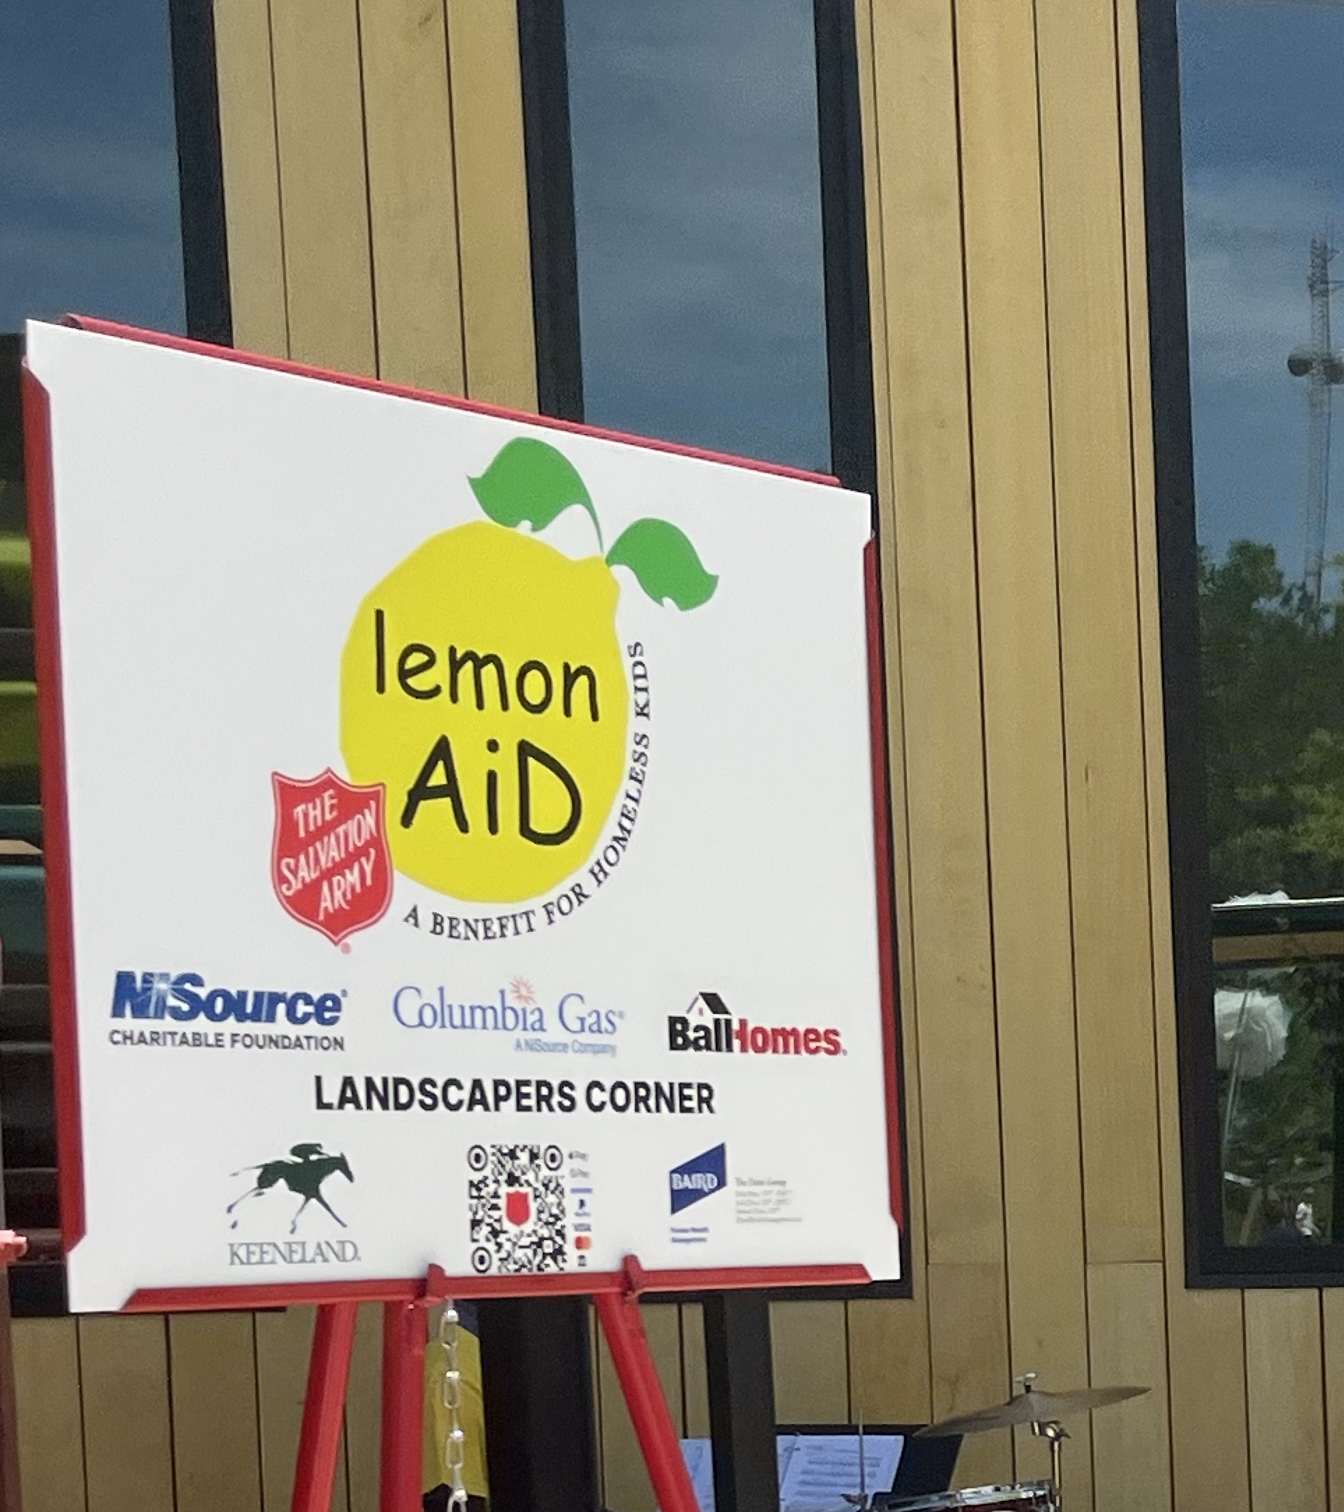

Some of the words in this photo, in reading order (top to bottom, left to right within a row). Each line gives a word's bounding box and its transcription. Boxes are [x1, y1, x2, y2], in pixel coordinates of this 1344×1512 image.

[375, 609, 600, 722] lemon
[293, 789, 339, 838] THE
[401, 735, 582, 846] AiD
[403, 905, 421, 929] A
[430, 910, 536, 941] BENEFIT
[542, 882, 591, 926] FOR
[588, 732, 650, 888] HOMELESS
[627, 641, 651, 721] KIDS
[280, 800, 378, 896] SALVATION
[318, 848, 376, 921] ARMY
[392, 986, 547, 1033] Columbia
[558, 993, 618, 1035] Gas
[108, 1030, 224, 1049] CHARITABLE
[230, 1033, 345, 1052] FOUNDATION
[571, 1040, 617, 1057] Company
[314, 1075, 577, 1113] LANDSCAPERS
[585, 1079, 716, 1114] CORNER
[671, 1172, 718, 1192] BAIRD
[228, 1240, 359, 1266] KEENELAND
